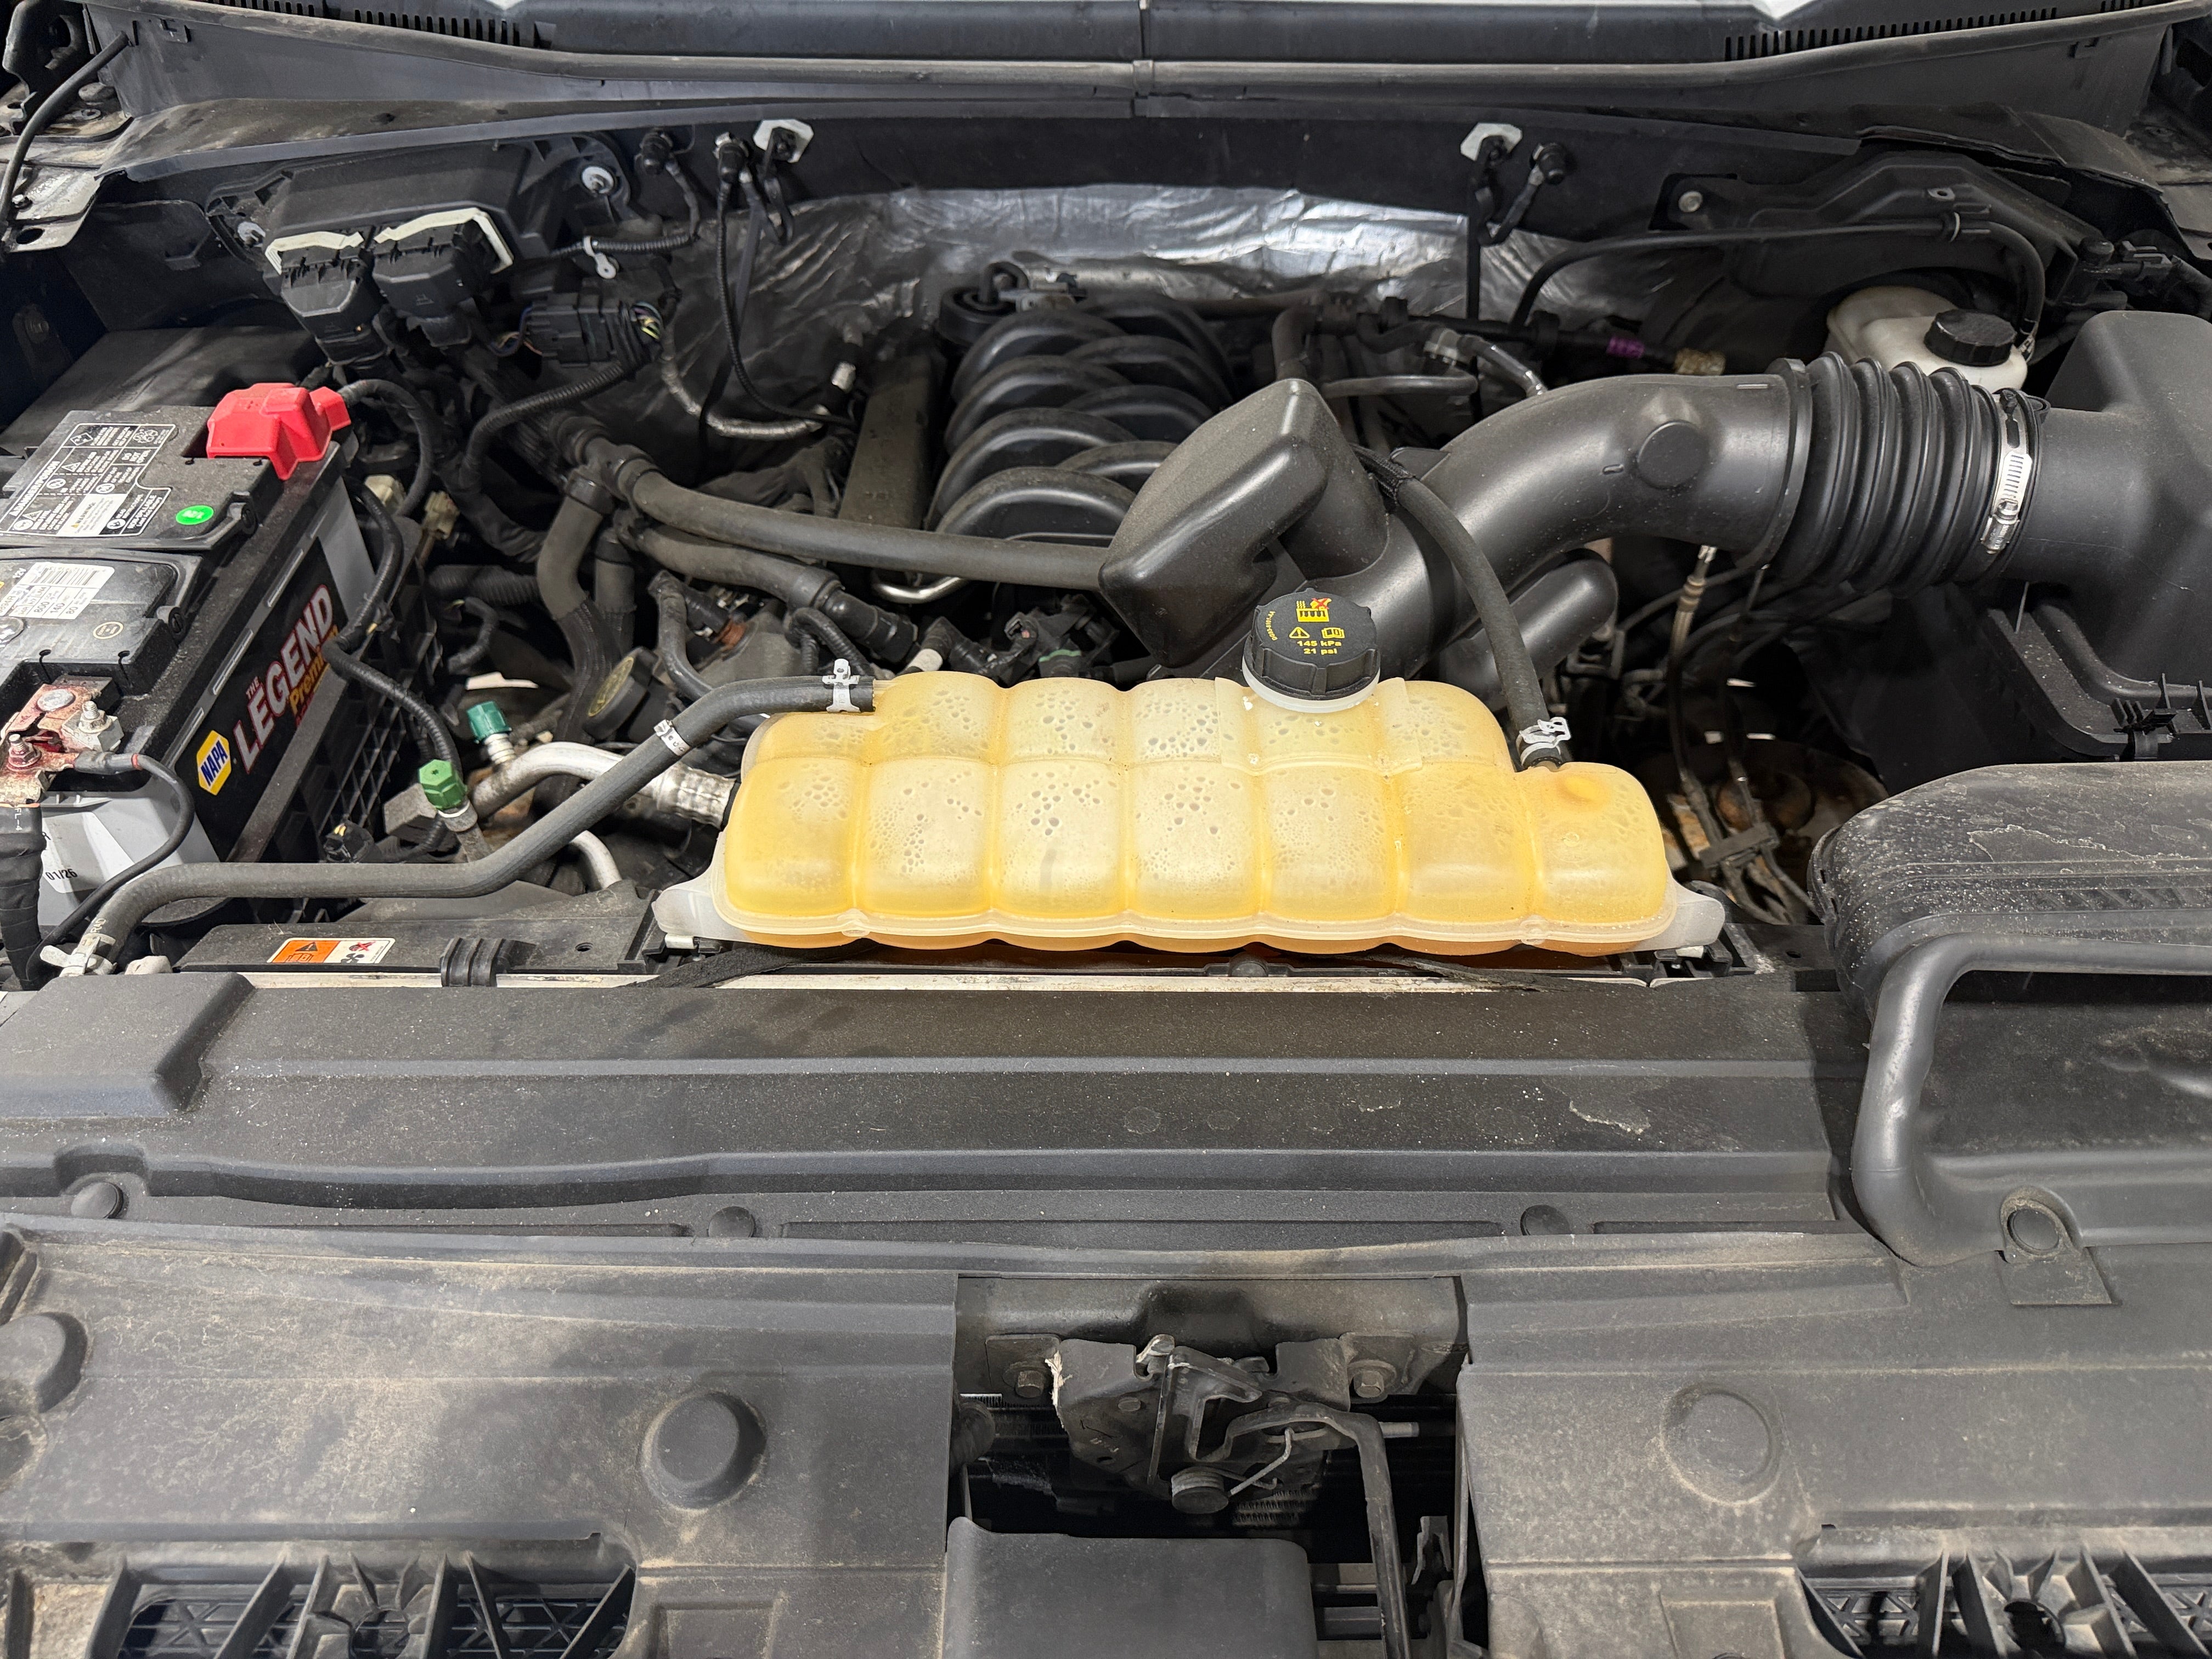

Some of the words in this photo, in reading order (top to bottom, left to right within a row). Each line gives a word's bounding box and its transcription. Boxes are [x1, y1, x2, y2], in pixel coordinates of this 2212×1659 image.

[16, 461, 60, 510] DANGER/POISON
[33, 601, 50, 613] 800
[50, 602, 65, 614] 140
[66, 606, 78, 615] 80
[233, 584, 334, 775] LEGEND
[245, 675, 260, 699] THE
[200, 740, 228, 787] NAPA
[45, 868, 78, 881] 01/26
